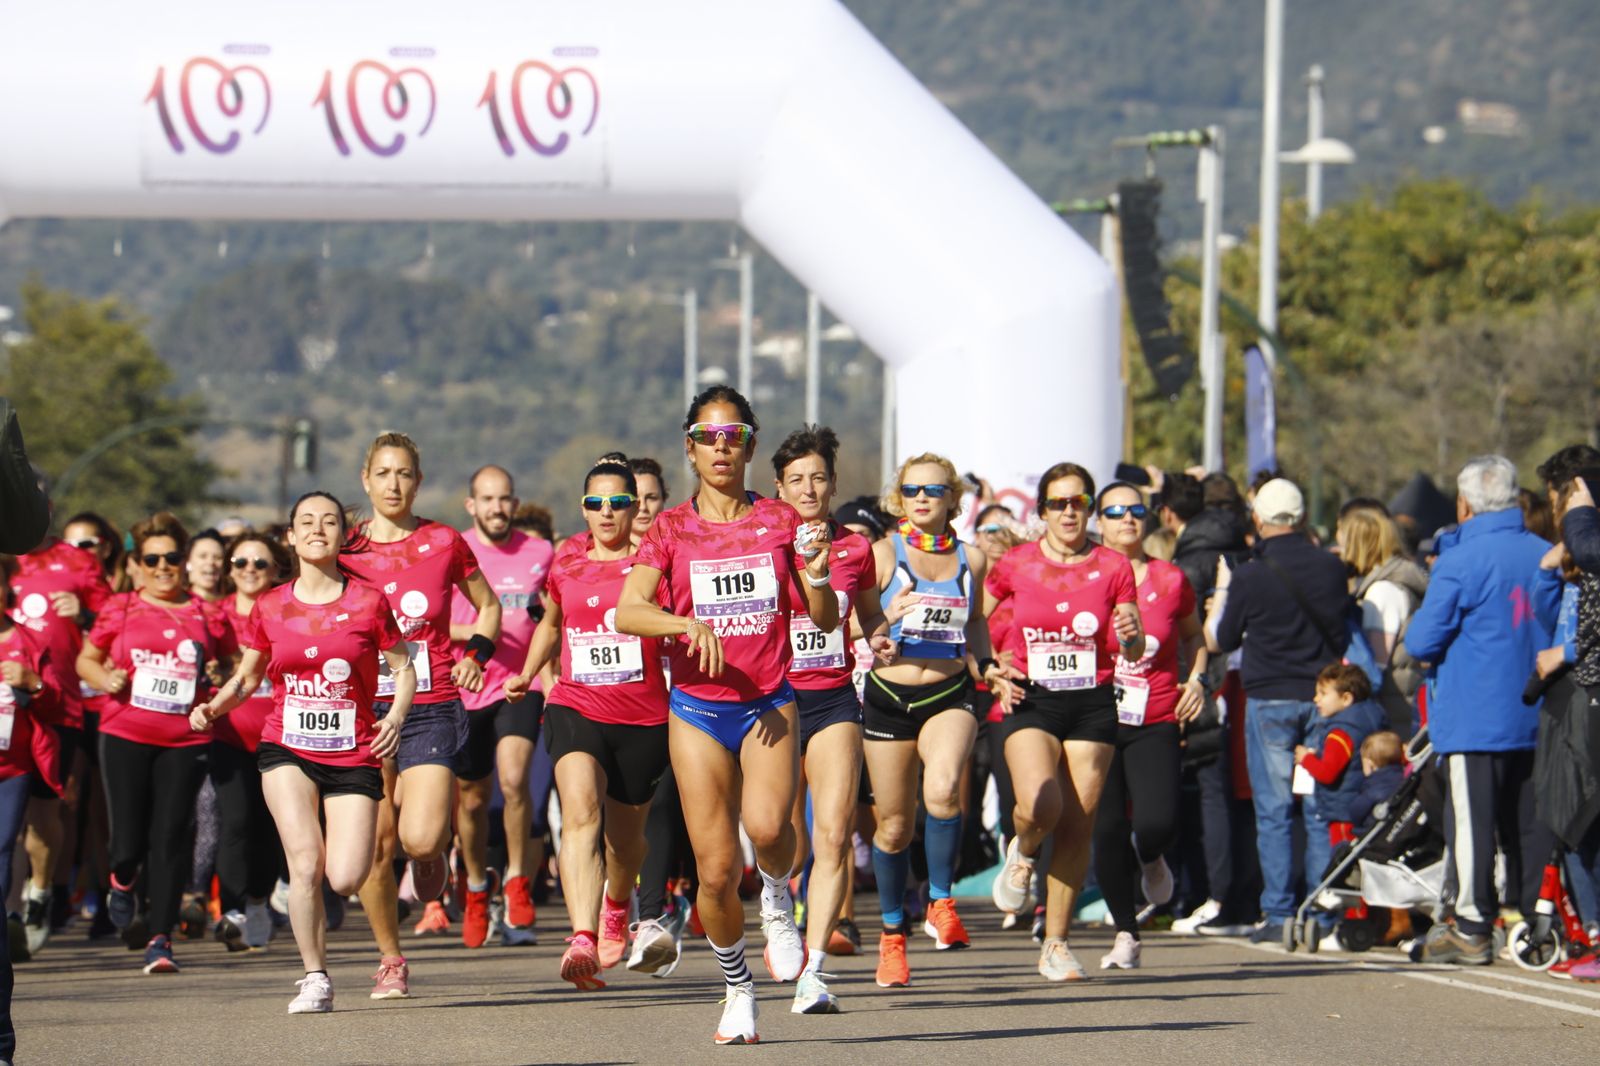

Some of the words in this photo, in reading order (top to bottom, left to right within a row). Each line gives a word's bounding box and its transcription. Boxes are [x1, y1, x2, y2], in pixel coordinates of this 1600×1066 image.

[712, 572, 755, 595] 1119
[922, 608, 952, 624] 243
[713, 624, 767, 637] RUNNING
[797, 631, 826, 650] 375
[130, 648, 180, 670] Pink
[590, 646, 621, 665] 681
[1047, 654, 1077, 671] 494
[152, 678, 178, 695] 708
[282, 673, 331, 697] Pink
[298, 711, 340, 730] 1094
